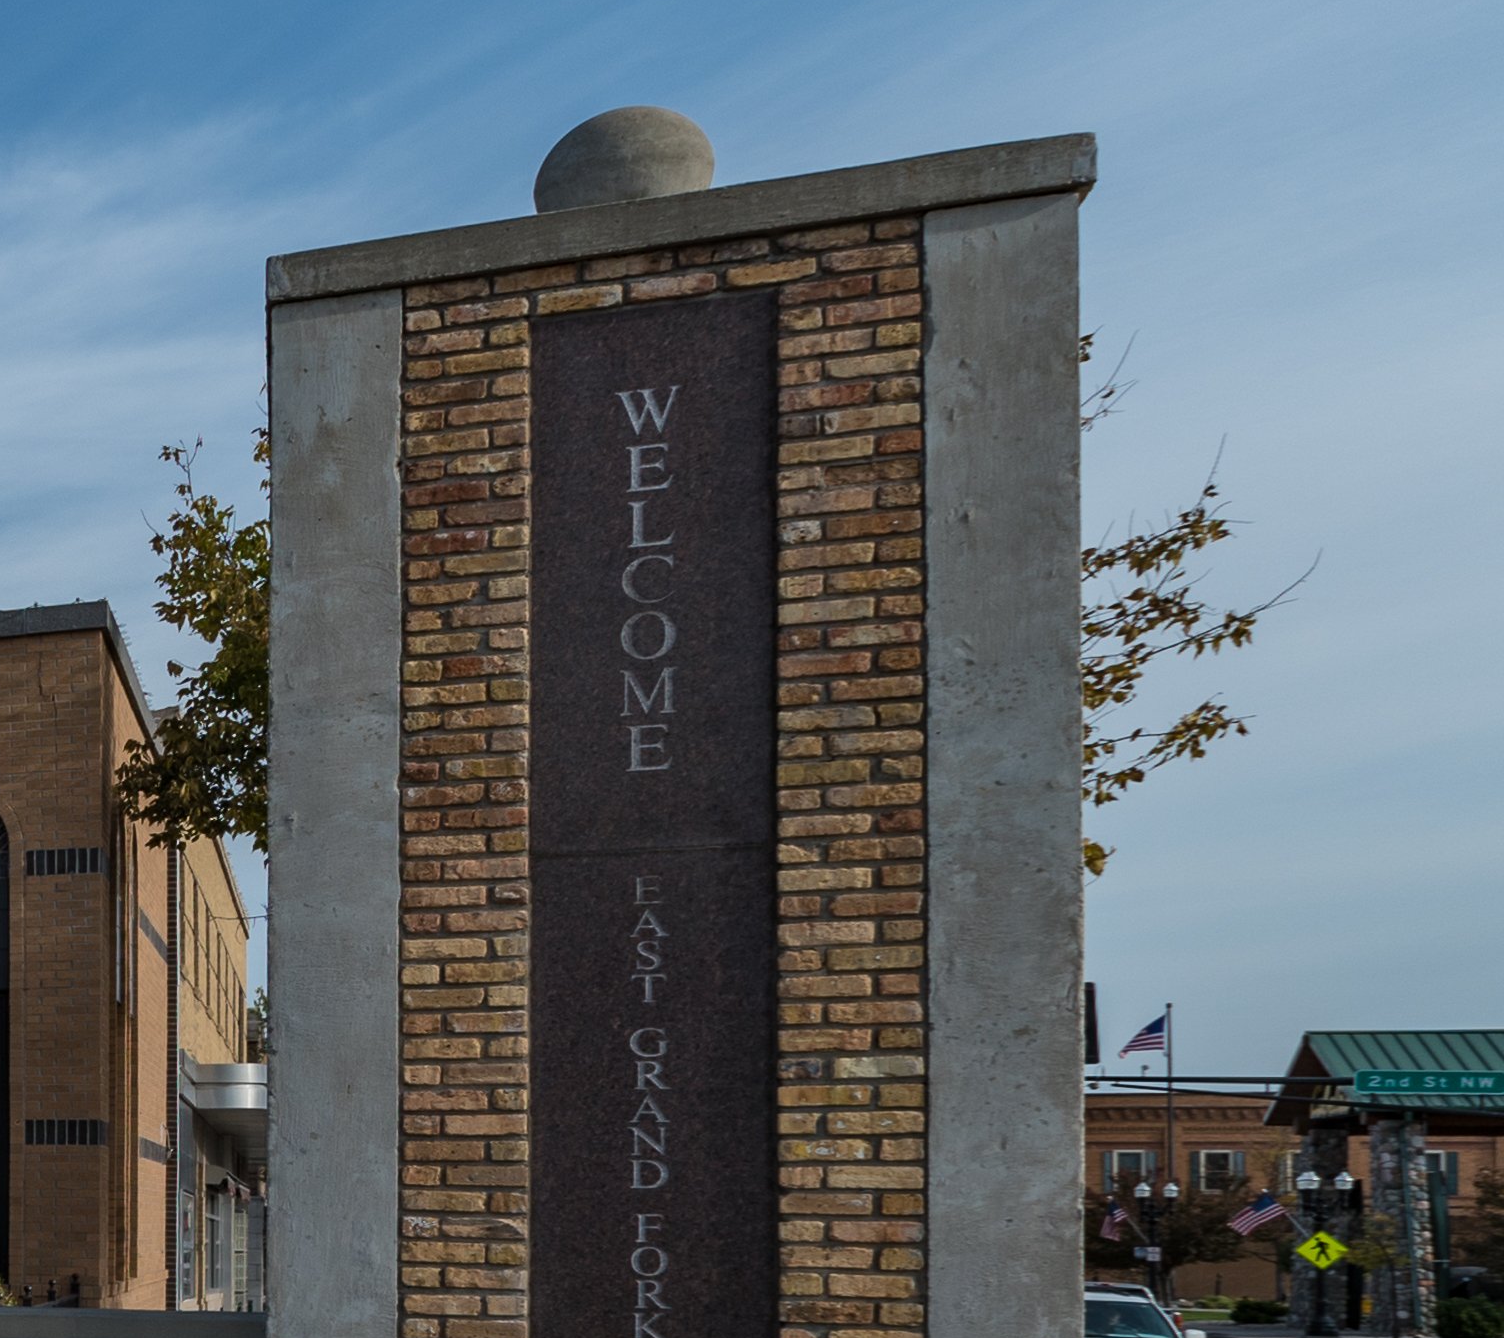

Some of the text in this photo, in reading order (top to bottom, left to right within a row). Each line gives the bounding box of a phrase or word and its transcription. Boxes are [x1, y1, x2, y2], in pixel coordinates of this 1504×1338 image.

[616, 385, 681, 774] WELCOME
[633, 874, 668, 1004] EAST
[628, 1026, 671, 1190] GRAND
[1367, 1075, 1496, 1088] 2nd St NW
